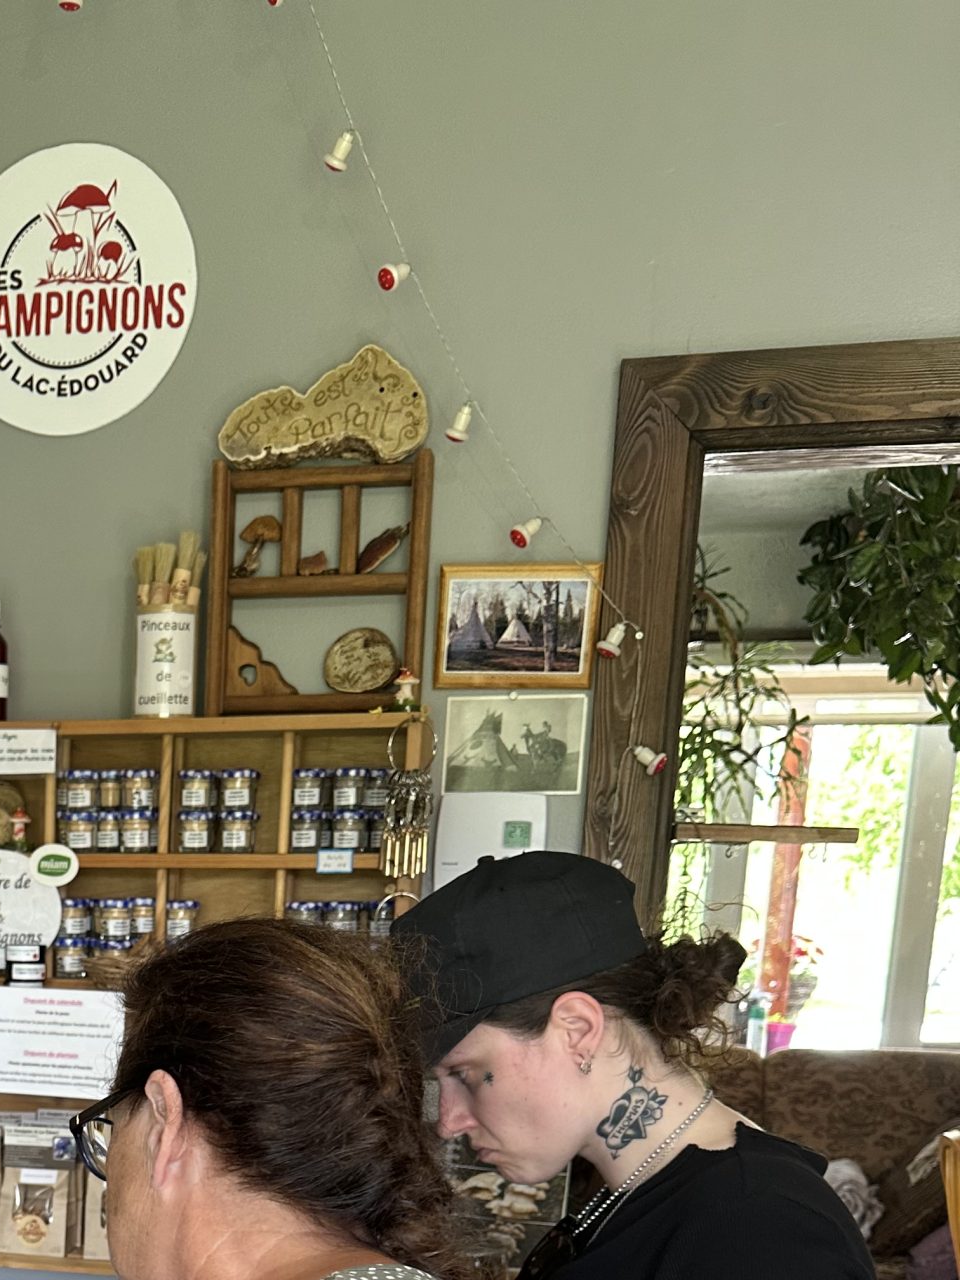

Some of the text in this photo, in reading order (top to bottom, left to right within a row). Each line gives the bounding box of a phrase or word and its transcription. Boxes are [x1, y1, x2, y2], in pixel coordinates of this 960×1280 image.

[11, 332, 148, 397] LAC-ÉDOUARD
[313, 367, 354, 407] est
[289, 400, 402, 444] Parfait
[140, 620, 191, 632] Pinceaux
[156, 670, 172, 682] de
[14, 873, 31, 890] de
